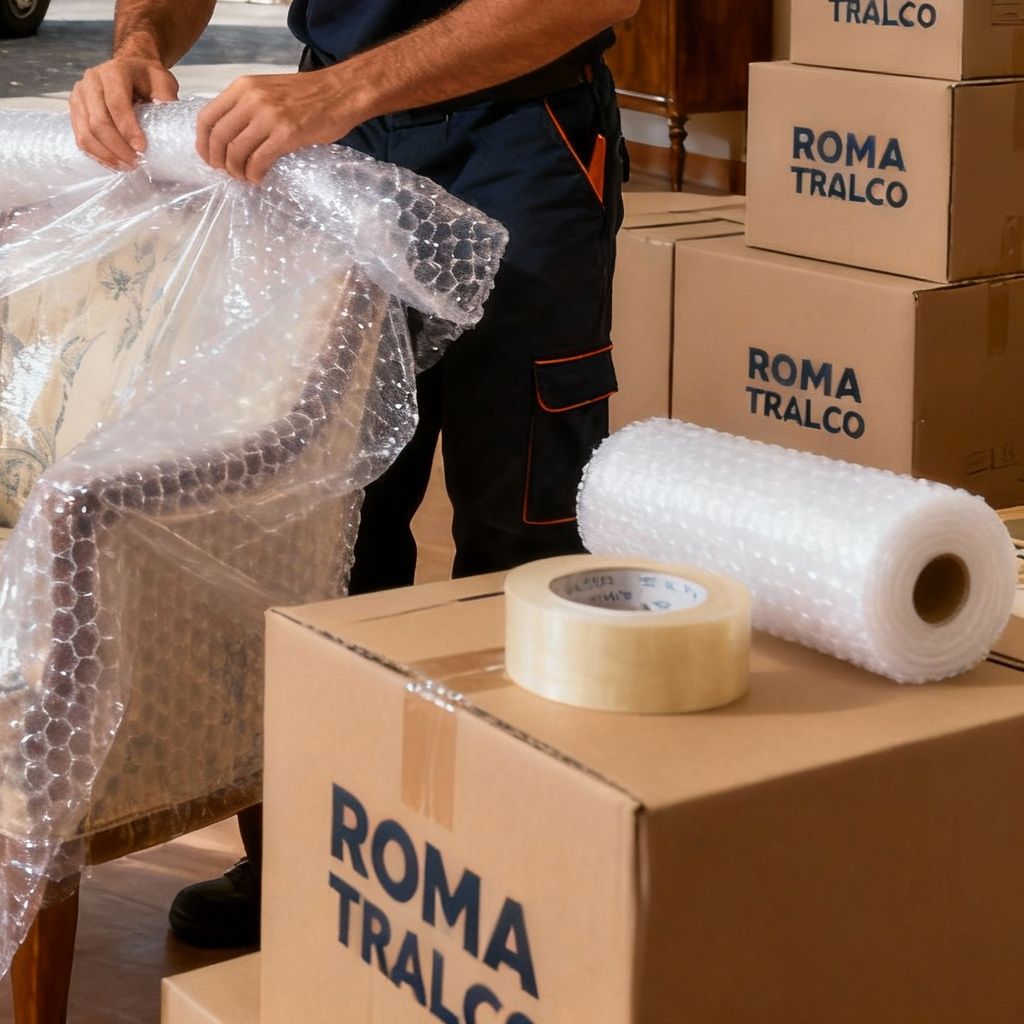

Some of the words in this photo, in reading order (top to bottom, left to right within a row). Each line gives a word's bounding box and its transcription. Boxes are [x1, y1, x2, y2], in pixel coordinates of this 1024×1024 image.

[792, 126, 906, 172] ROMA
[791, 166, 908, 209] TRALCO
[748, 346, 862, 404] ROMA
[745, 386, 866, 439] TRALCO
[331, 782, 539, 1000] ROMA
[329, 871, 537, 1024] TRALC
